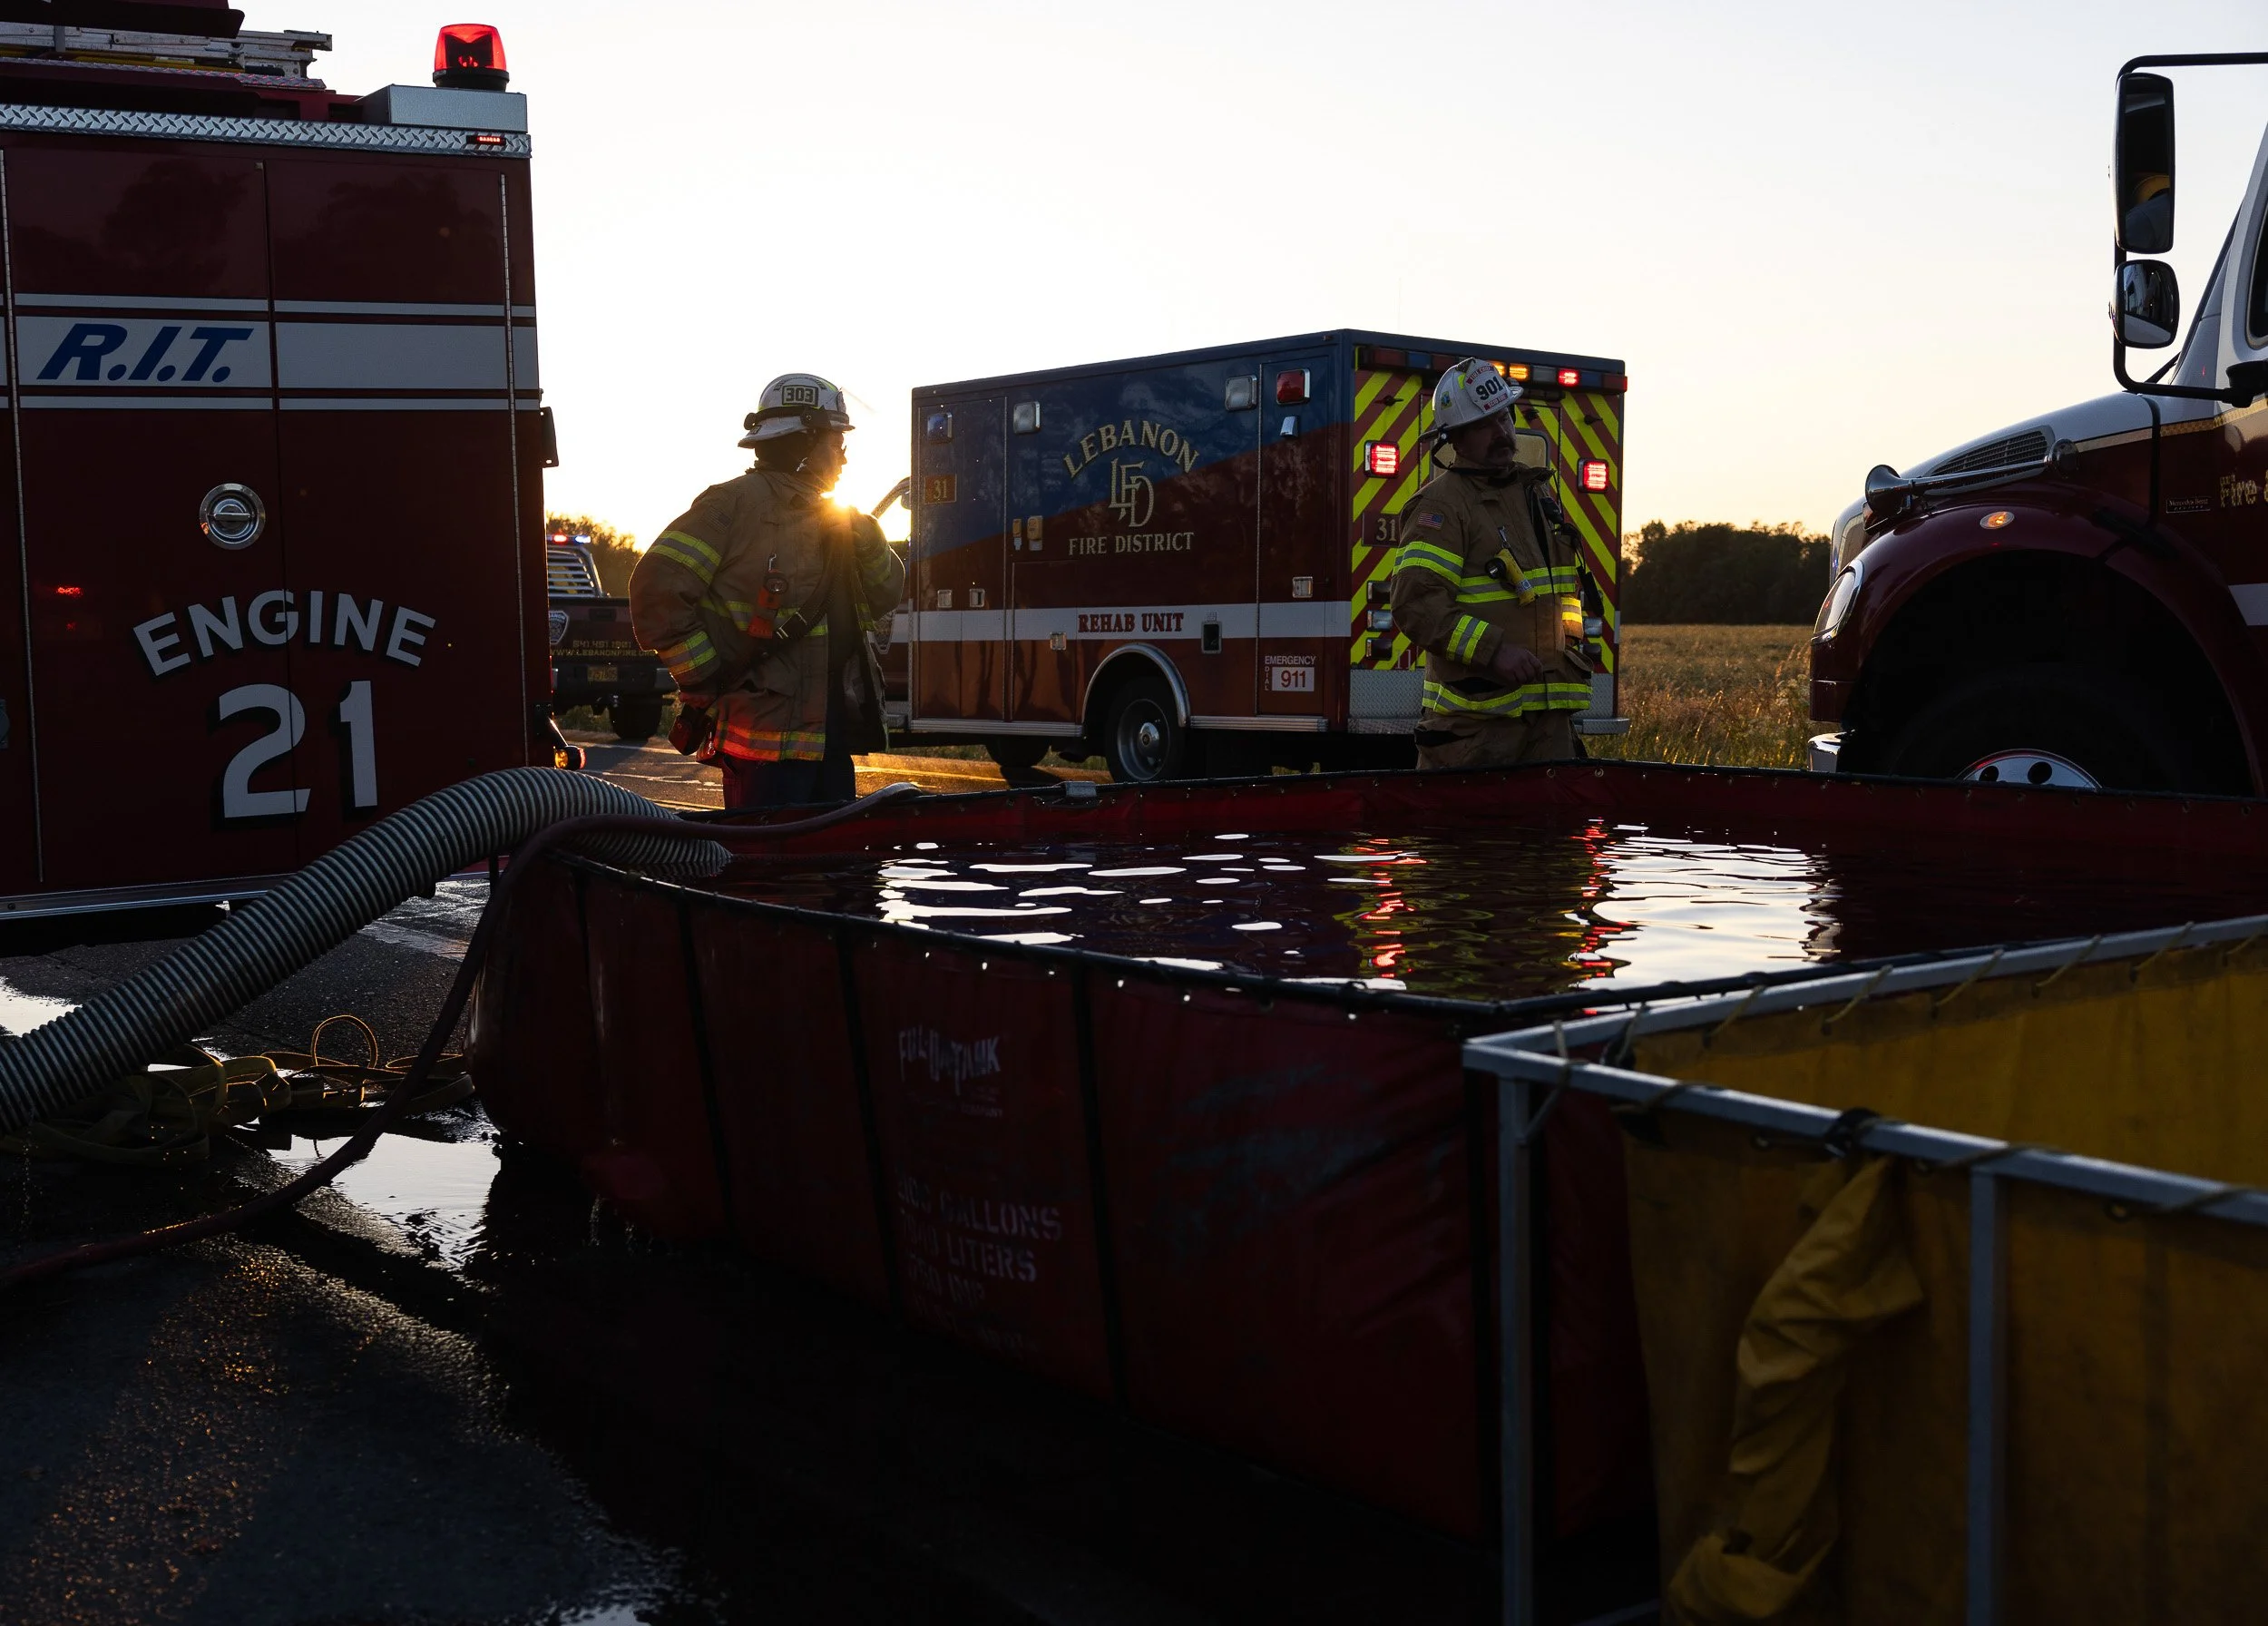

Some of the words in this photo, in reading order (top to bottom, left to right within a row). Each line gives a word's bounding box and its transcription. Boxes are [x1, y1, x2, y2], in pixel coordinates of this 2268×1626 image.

[36, 323, 254, 382] R.I.T.
[785, 387, 815, 404] 303
[1475, 376, 1504, 400] 901
[1063, 419, 1200, 478] LEBANON
[934, 478, 948, 500] 31
[1108, 456, 1155, 528] LFD
[1375, 517, 1398, 542] 31
[1068, 536, 1108, 556] FIRE
[1115, 532, 1195, 554] DISTRICT
[132, 589, 436, 678] ENGINE
[1078, 612, 1136, 633] REHAB
[1141, 612, 1184, 632] UNIT
[1265, 655, 1316, 665] EMERGENCY
[1281, 670, 1306, 688] 911
[218, 680, 379, 820] 21
[939, 1188, 1062, 1242] GALLONS
[946, 1231, 1038, 1283] LITERS
